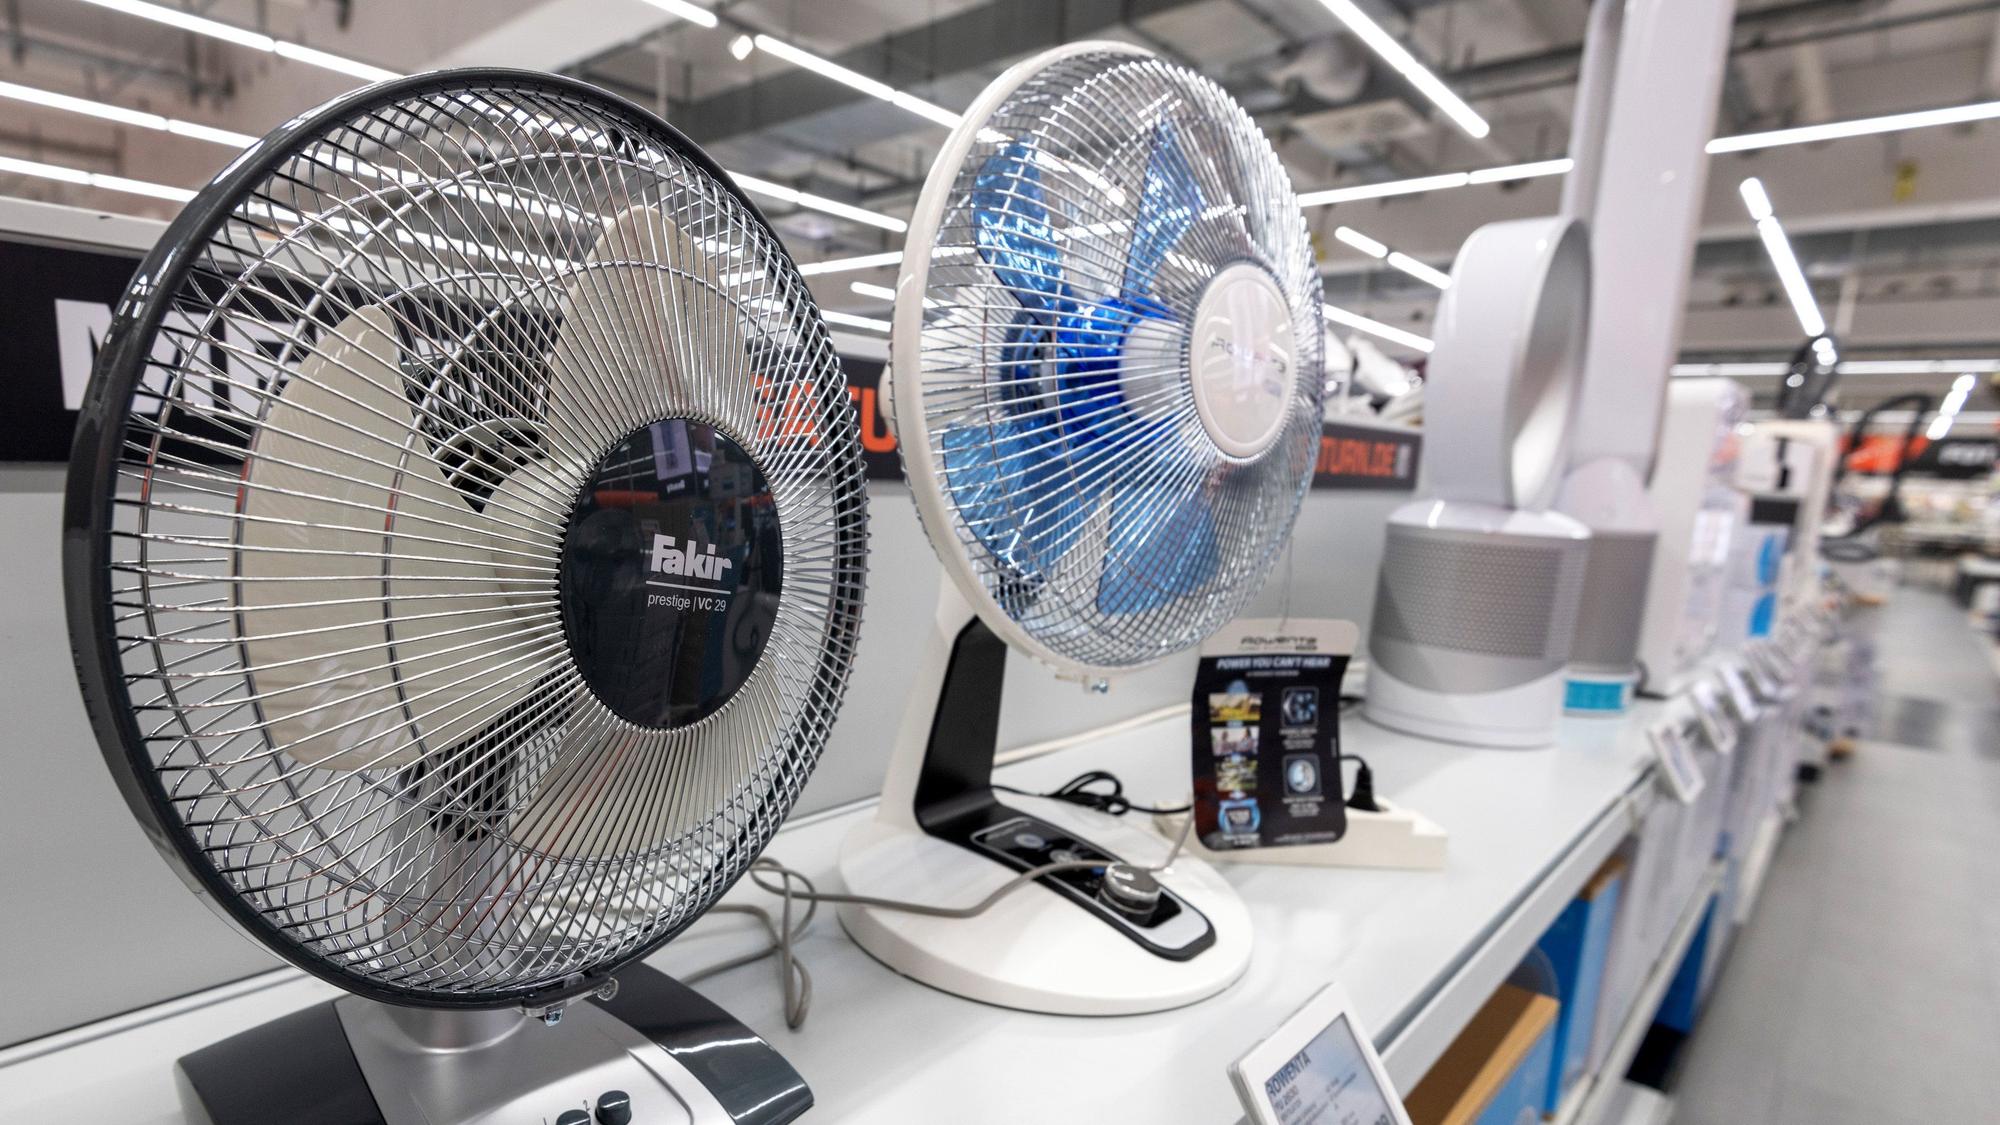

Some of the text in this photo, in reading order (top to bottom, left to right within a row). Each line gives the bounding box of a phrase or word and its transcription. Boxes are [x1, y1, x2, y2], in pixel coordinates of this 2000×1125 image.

[650, 533, 732, 581] Fakir
[647, 593, 691, 611] prestige
[714, 600, 727, 612] 29
[1217, 656, 1331, 669] POWER YOU CAN'T HEAR
[1265, 1050, 1312, 1097] ROWENTA
